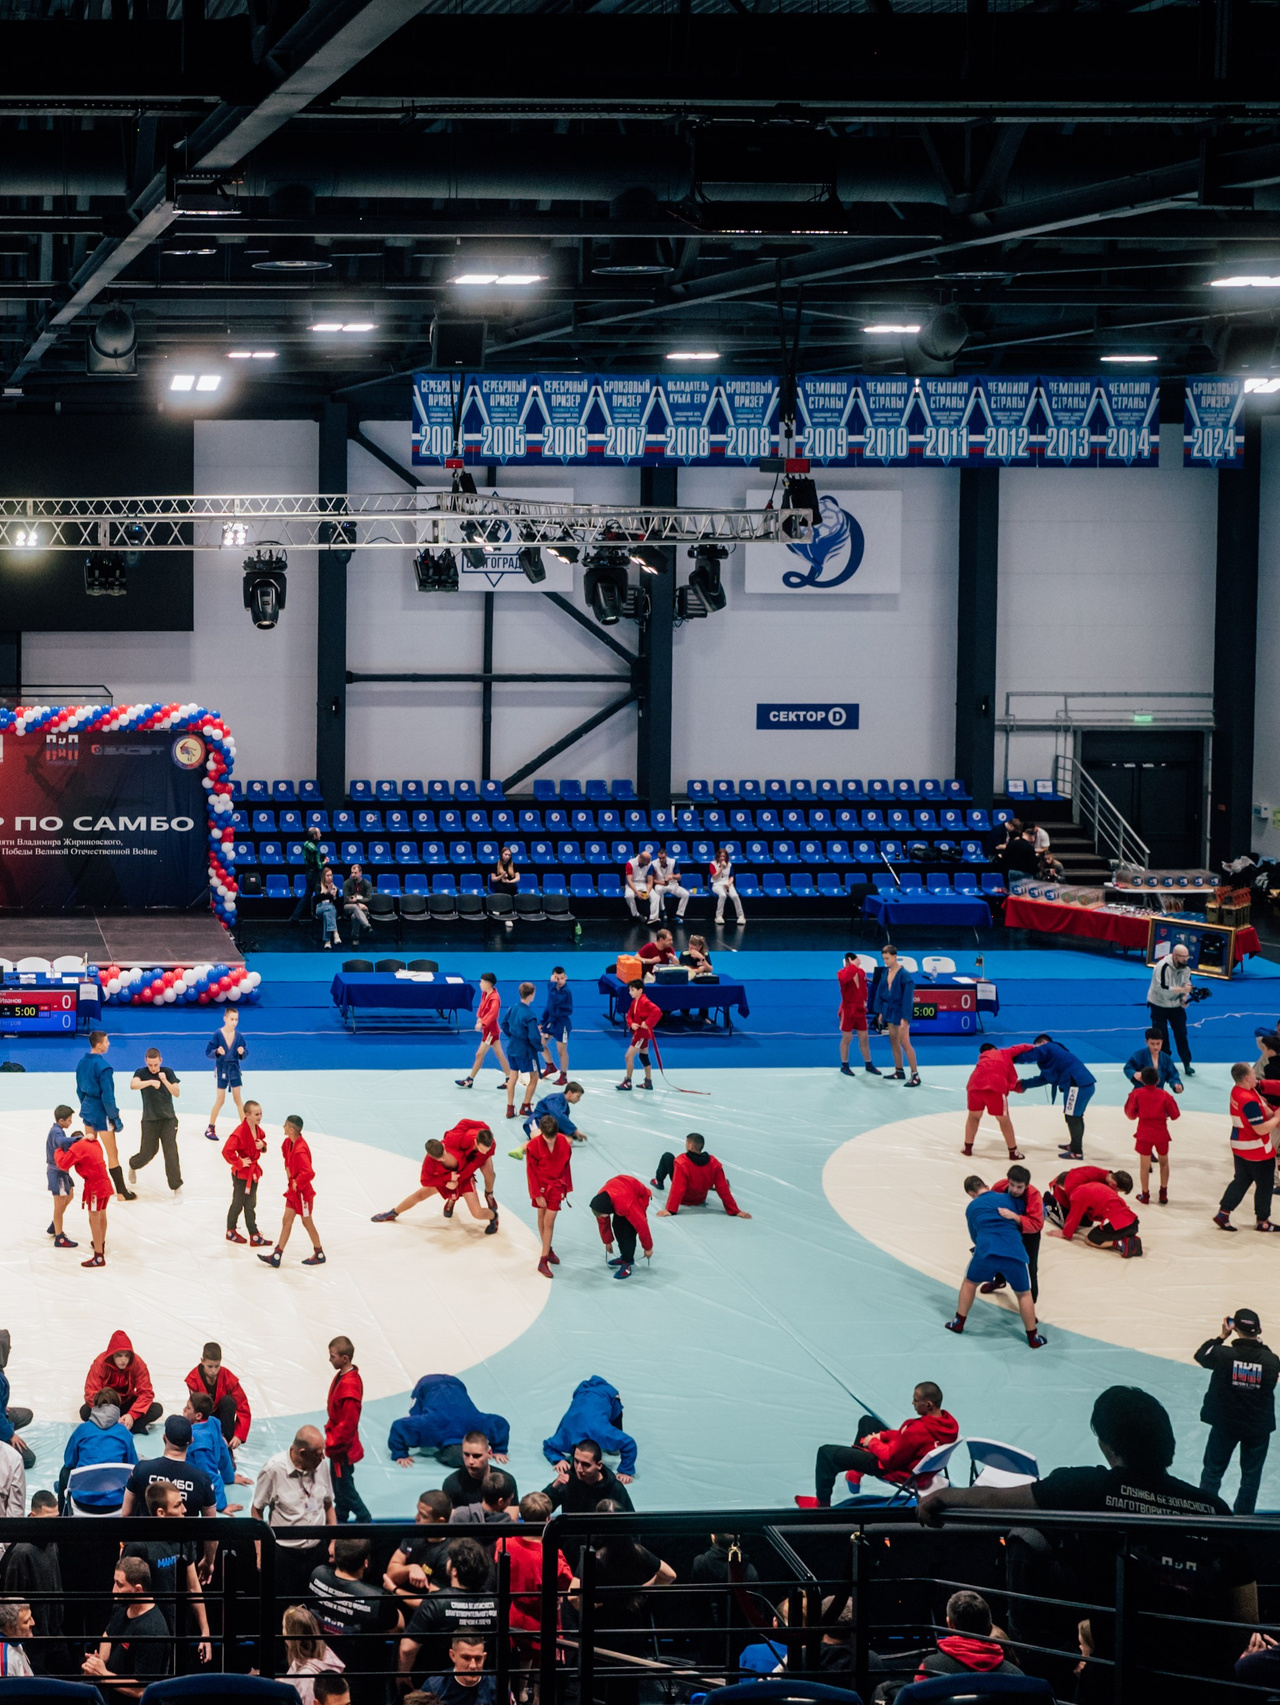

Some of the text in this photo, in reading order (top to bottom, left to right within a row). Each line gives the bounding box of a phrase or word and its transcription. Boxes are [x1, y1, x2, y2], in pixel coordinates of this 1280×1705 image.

[483, 379, 526, 393] СЕРЕБРЯНЫЙ
[544, 379, 588, 393] СЕРЕБРЯНЫЙ
[604, 379, 650, 394] БРОНЗОВЫЙ
[667, 381, 709, 392] ОБЛАДАТЕЛЬ
[726, 380, 772, 394] БРОНЗОВЫЙ
[805, 382, 847, 394] ЧЕМПИОН
[866, 382, 907, 394] ЧЕМПИОН
[926, 382, 968, 394] ЧЕМПИОН
[988, 382, 1029, 394] ЧЕМПИОН
[1049, 382, 1090, 394] ЧЕМПИОН
[1109, 382, 1150, 395] ЧЕМПИОН
[490, 394, 519, 407] ПРИЗЕР
[551, 394, 580, 407] ПРИЗЕР
[612, 395, 642, 408] ПРИЗЕР
[670, 394, 691, 403] КУБКА
[734, 395, 764, 408] ПРИЗЕР
[809, 396, 843, 409] СТРАНЫ
[870, 396, 904, 409] СТРАНЫ
[930, 396, 964, 408] СТРАНЫ
[991, 396, 1026, 409] СТРАНЫ
[1052, 396, 1087, 409] СТРАНЫ
[1112, 397, 1146, 409] СТРАНЫ
[1201, 396, 1230, 408] ПРИЗЕР
[482, 426, 526, 455] 2005
[544, 426, 587, 455] 2006
[606, 426, 646, 456] 2007
[666, 426, 709, 456] 2008
[727, 426, 770, 456] 2008
[804, 427, 847, 456] 2009
[865, 427, 908, 456] 2010
[925, 427, 967, 456] 2011
[986, 427, 1029, 456] 2012
[1047, 427, 1089, 456] 2013
[1107, 427, 1149, 456] 2014
[1193, 428, 1235, 457] 2024
[769, 711, 826, 722] СЕКТОР
[15, 816, 63, 832] ПО
[73, 816, 195, 832] САМБО
[17, 838, 61, 846] Владимира
[63, 838, 123, 846] Жириновского,
[2, 848, 32, 856] Победы
[62, 995, 71, 1009] 0
[961, 994, 970, 1008] 0
[15, 1007, 36, 1016] 5:00
[914, 1007, 934, 1016] 5:00
[62, 1015, 71, 1028] 0
[962, 1016, 970, 1030] 0
[1120, 1484, 1216, 1515] СЛУЖБА БЕЗОПАСНОСТИ
